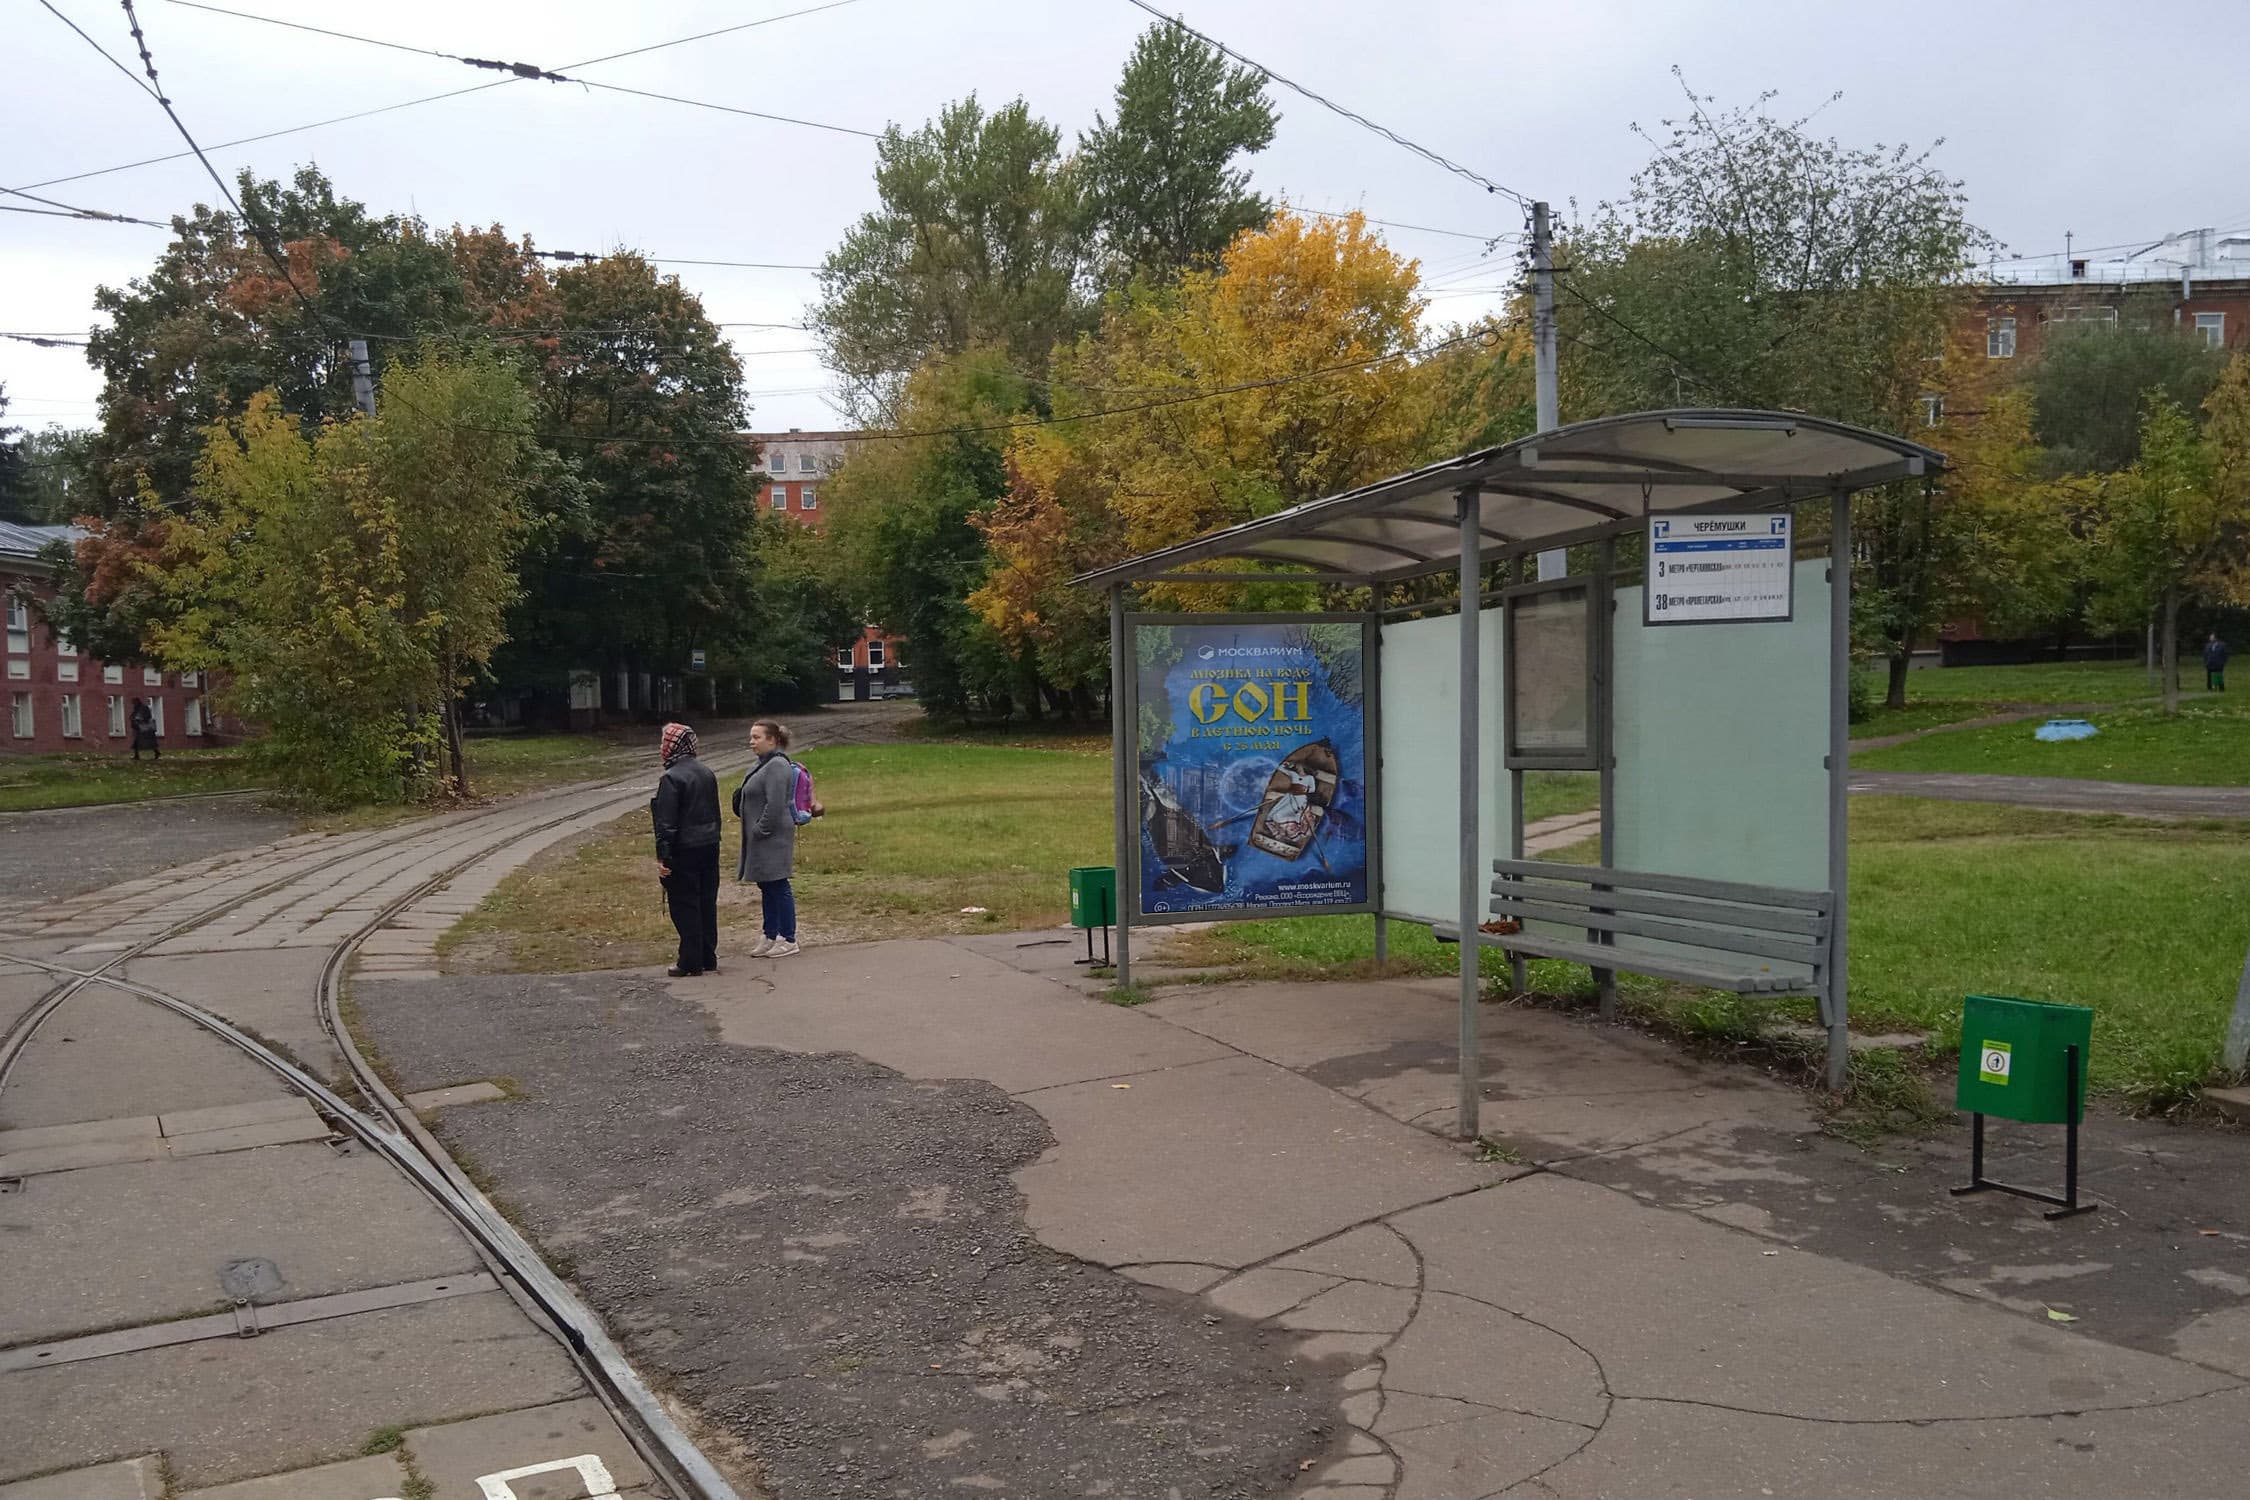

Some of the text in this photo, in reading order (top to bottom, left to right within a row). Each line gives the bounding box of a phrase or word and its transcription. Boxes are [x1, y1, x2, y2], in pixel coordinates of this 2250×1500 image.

[1694, 521, 1746, 532] ЧЕРЁМУШКИ
[1659, 561, 1665, 577] 3
[1656, 594, 1668, 610] 38
[1218, 647, 1302, 657] МОСКВАРИУМ
[1256, 669, 1273, 678] НА
[1188, 681, 1313, 725] СОН
[1191, 727, 1201, 738] В
[1275, 724, 1312, 736] НОЧЬ
